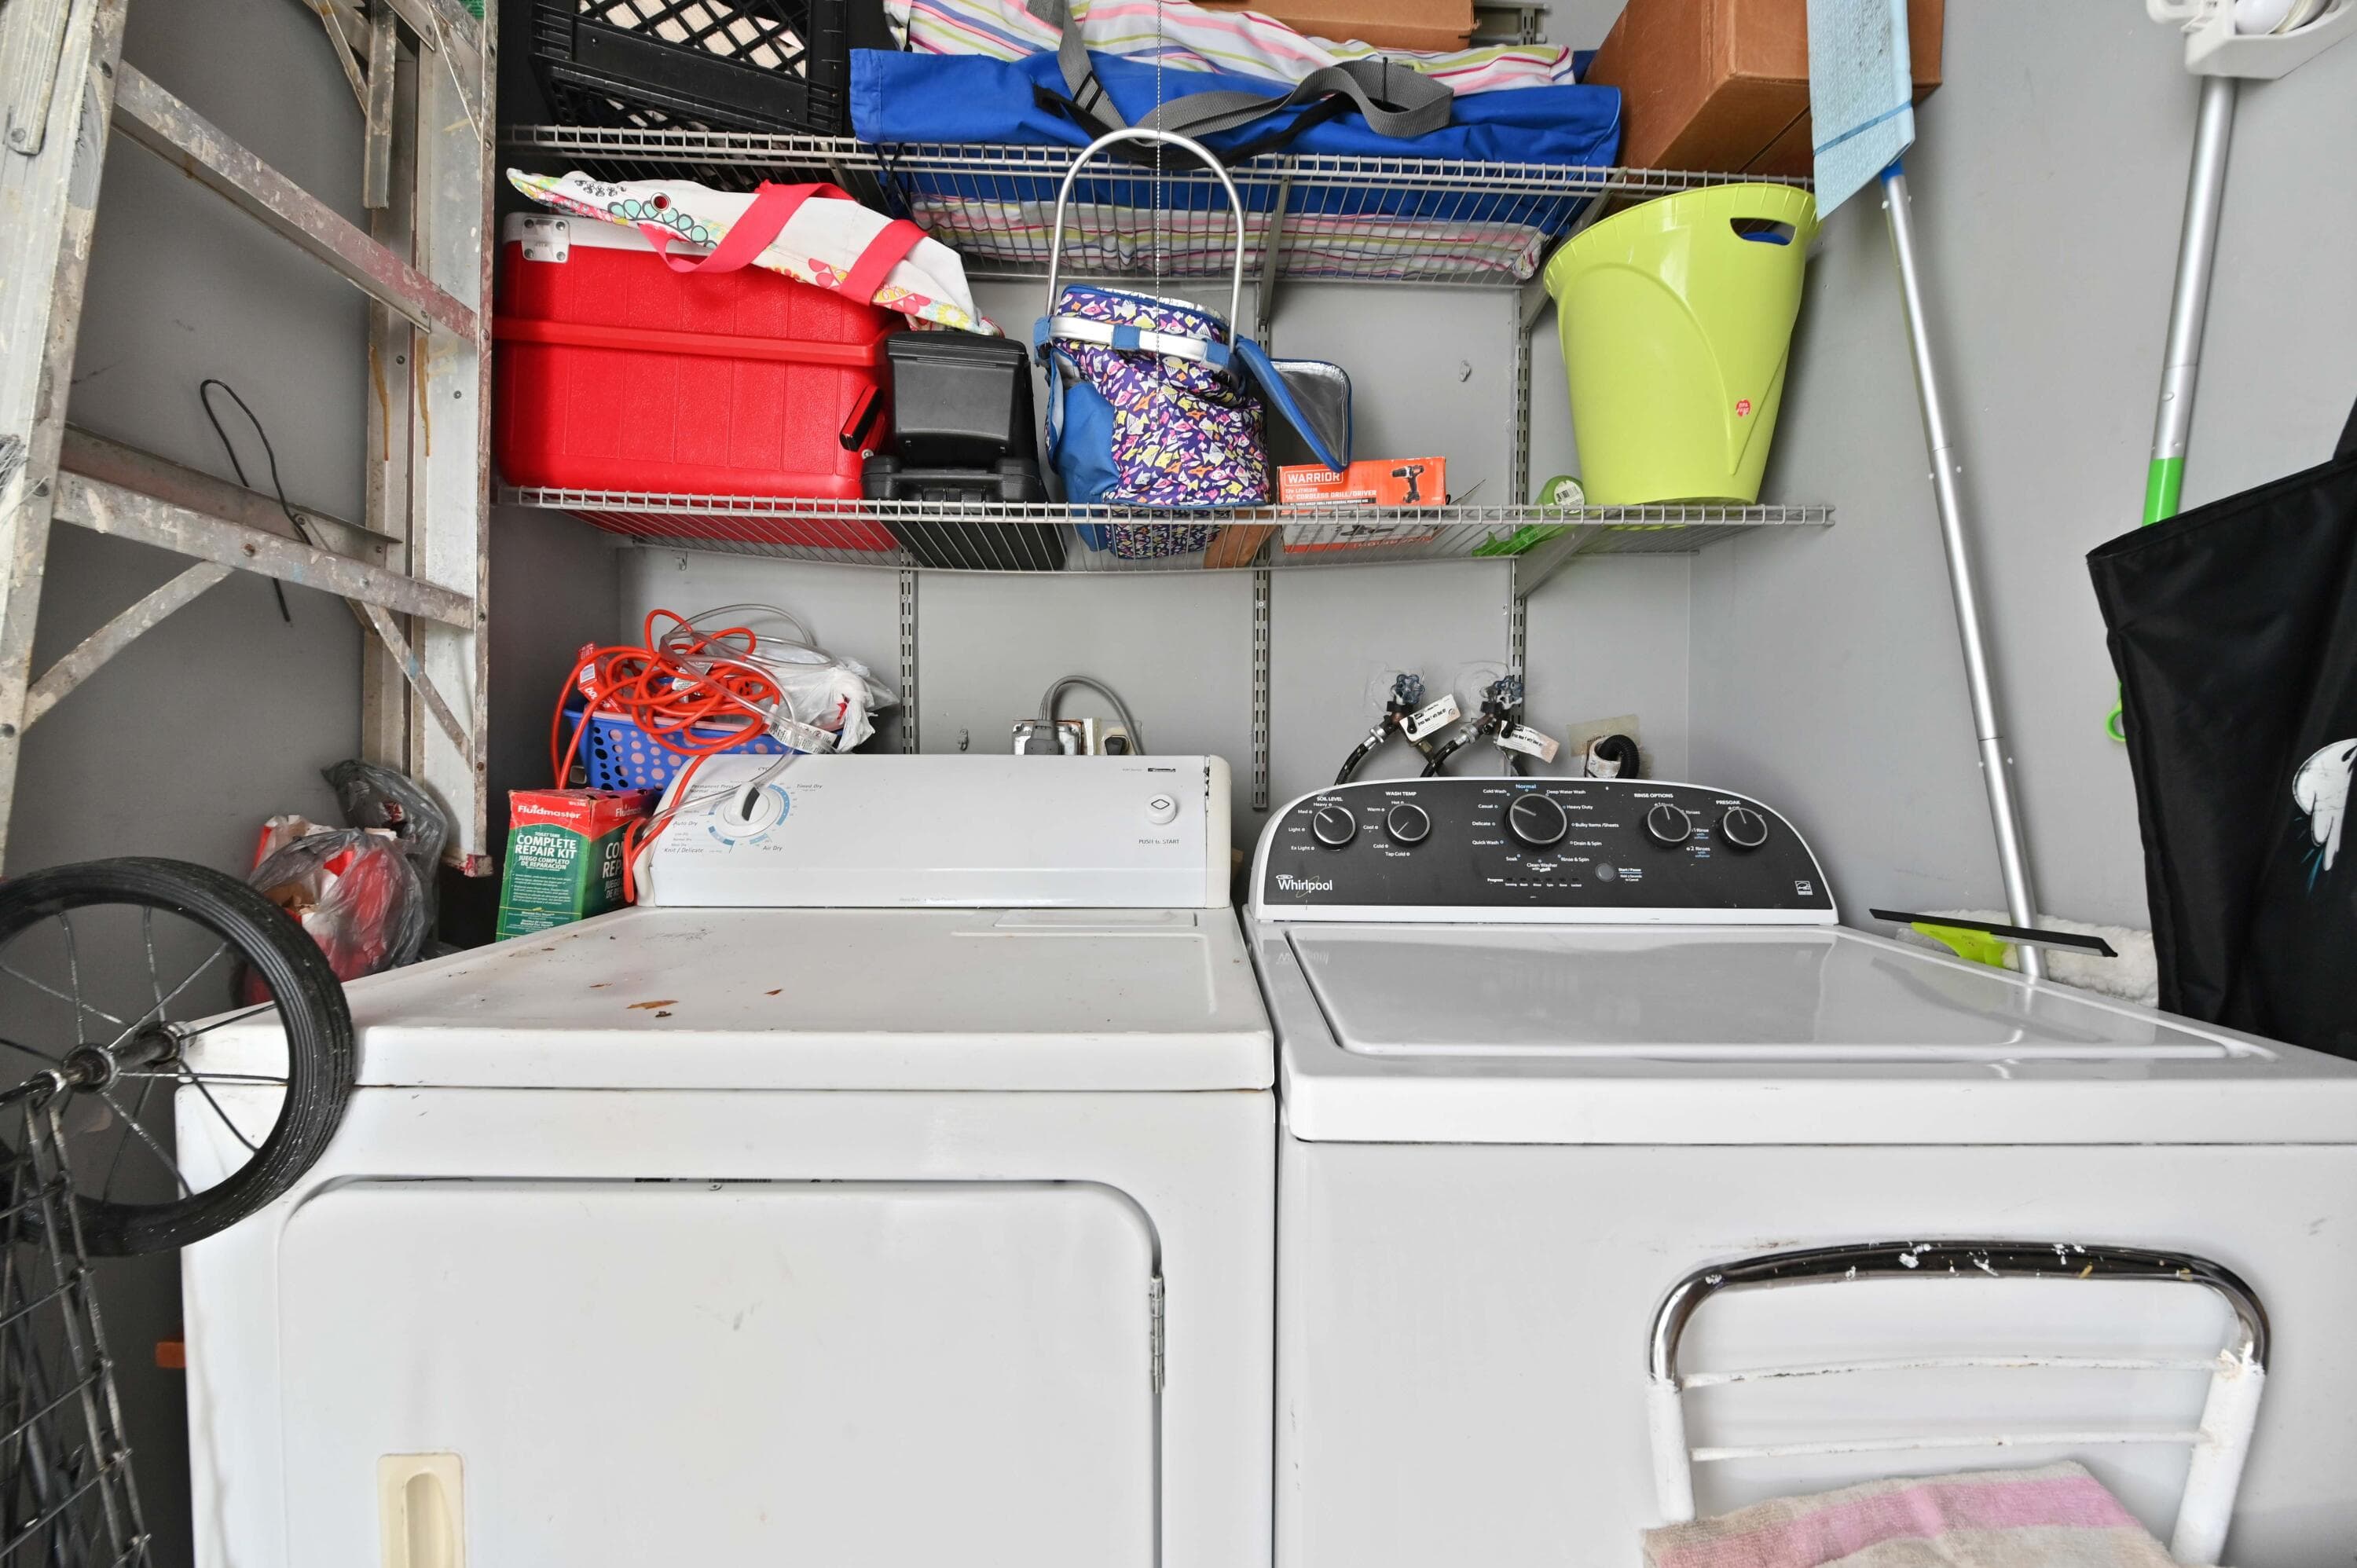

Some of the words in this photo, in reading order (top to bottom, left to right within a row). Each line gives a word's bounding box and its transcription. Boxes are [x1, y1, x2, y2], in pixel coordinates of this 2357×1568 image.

[1288, 472, 1340, 484] WARRIOR
[518, 804, 581, 819] Fluidmaster
[517, 835, 577, 849] COMPLETE
[515, 844, 555, 857] REPAIR
[558, 849, 577, 859] KIT
[1278, 880, 1332, 893] Whirlpool
